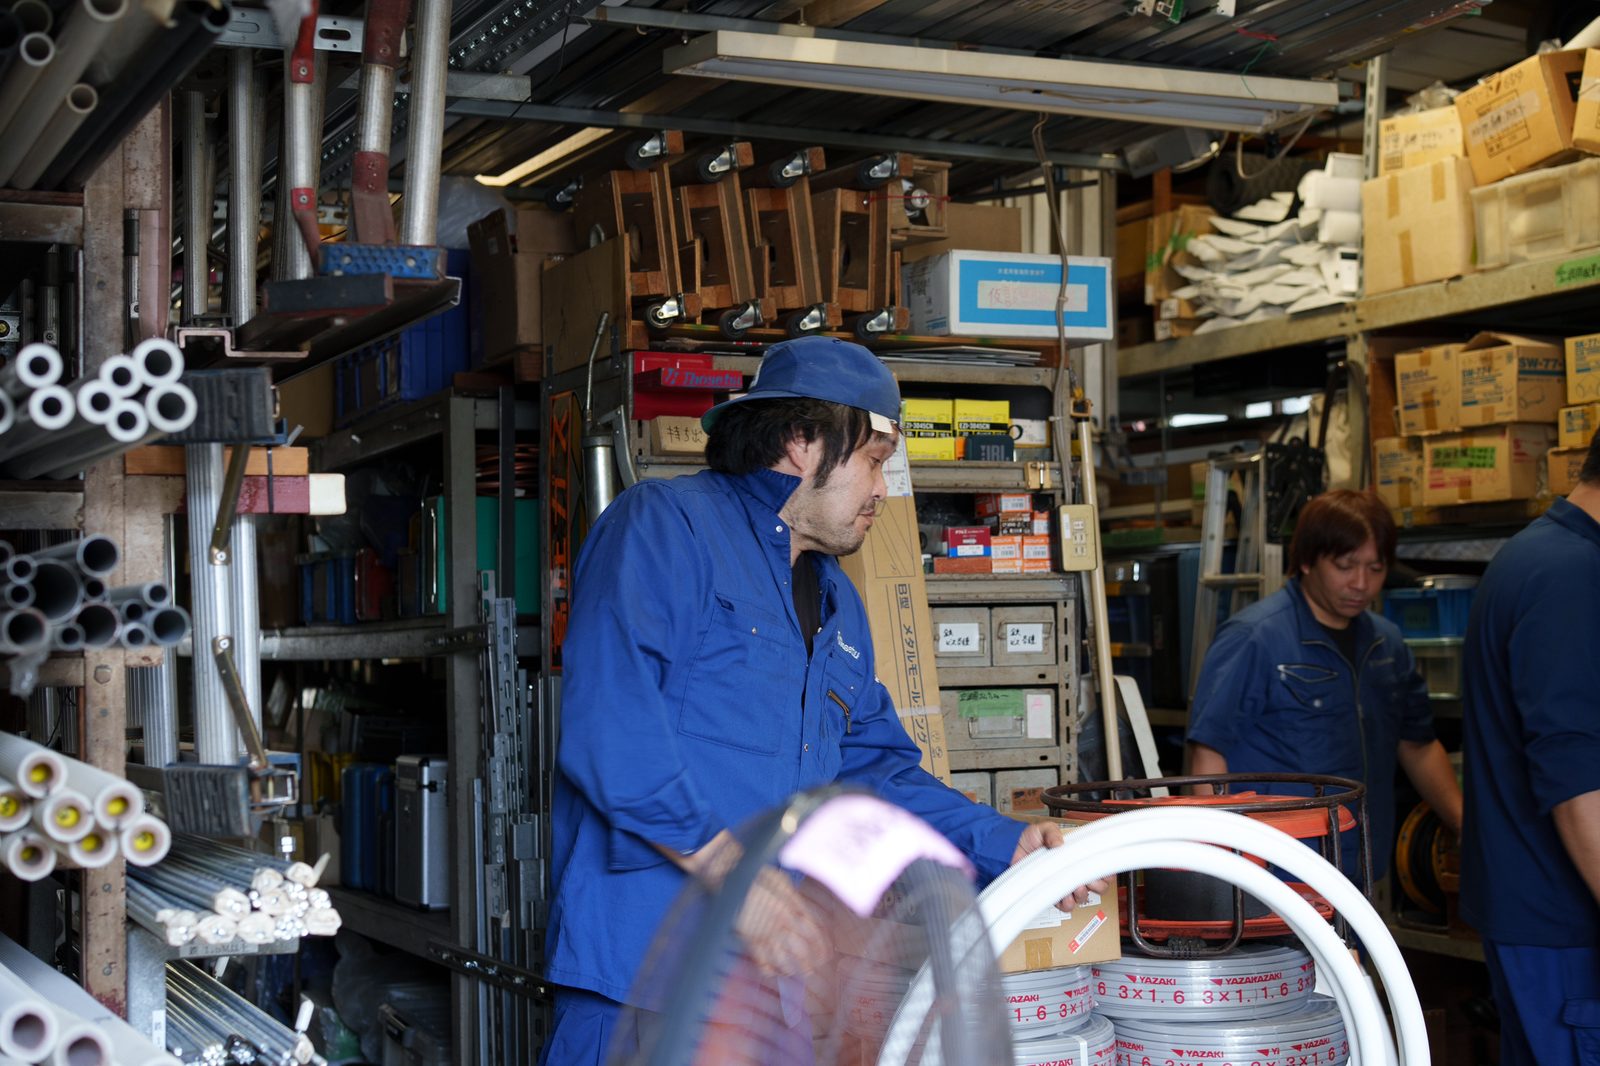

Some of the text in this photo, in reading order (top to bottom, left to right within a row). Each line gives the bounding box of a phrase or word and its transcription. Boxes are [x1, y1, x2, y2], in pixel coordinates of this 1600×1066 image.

[1139, 976, 1177, 986] YAZAKI
[1186, 1050, 1224, 1059] YAZAKI
[1304, 1038, 1330, 1049] YAZAKI
